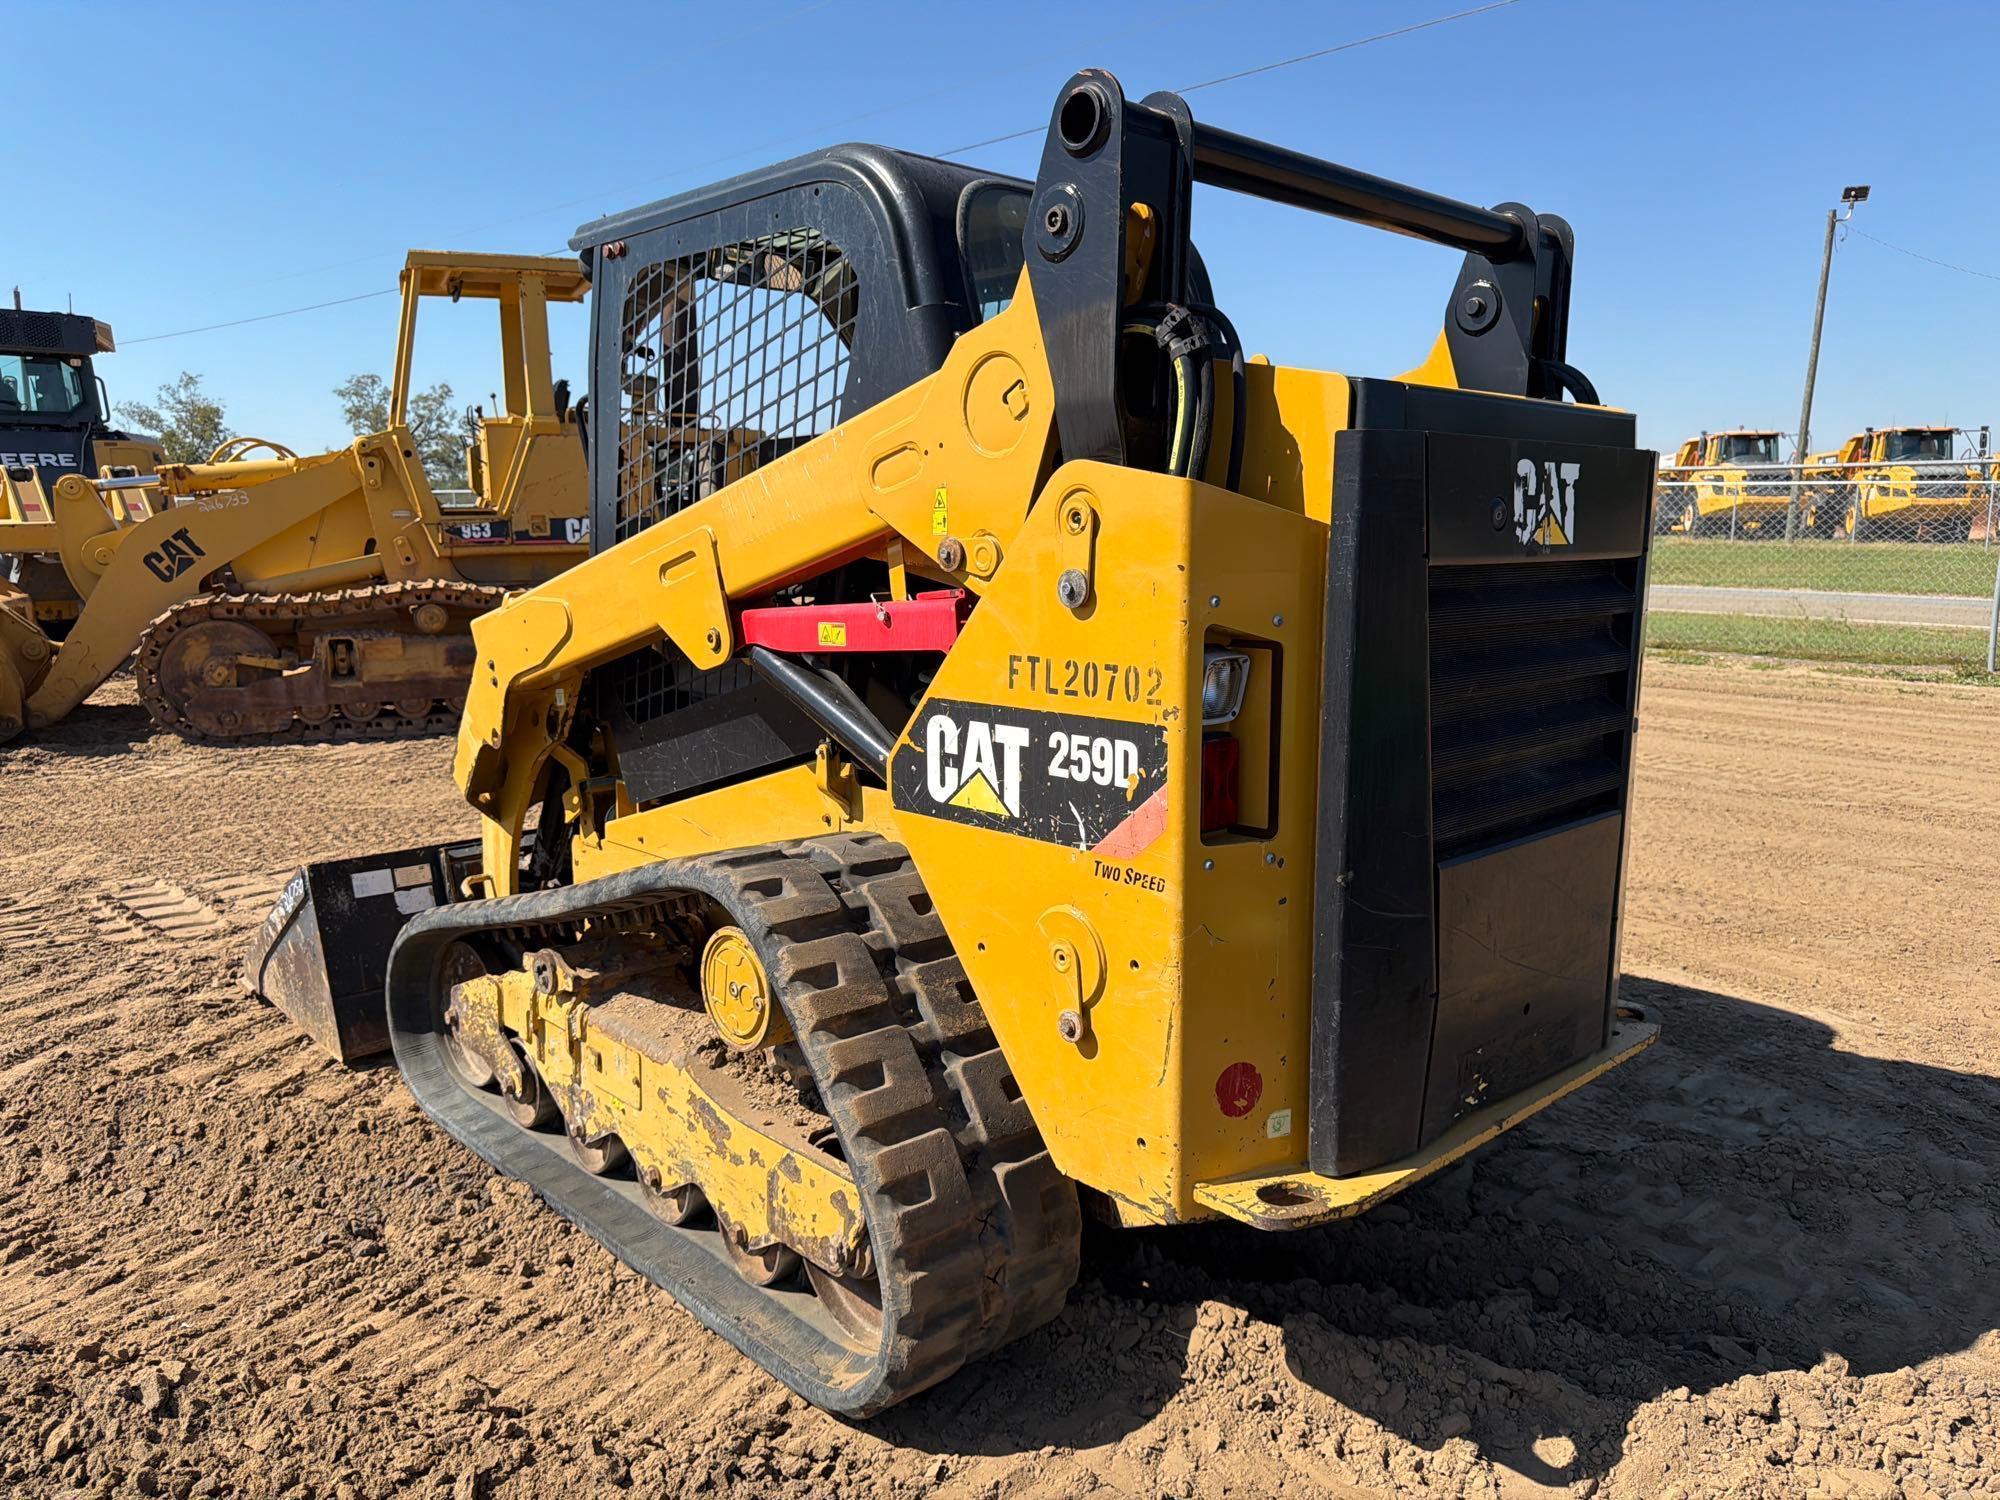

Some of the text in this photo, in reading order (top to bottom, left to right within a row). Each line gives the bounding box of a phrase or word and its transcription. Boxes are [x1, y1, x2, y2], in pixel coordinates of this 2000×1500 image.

[0, 453, 77, 468] EERE
[1513, 458, 1580, 545] CAT
[142, 527, 206, 583] CAT
[460, 522, 492, 539] 953
[565, 518, 591, 544] CA
[1008, 654, 1163, 706] FTL20702
[926, 714, 1140, 818] CAT 259D
